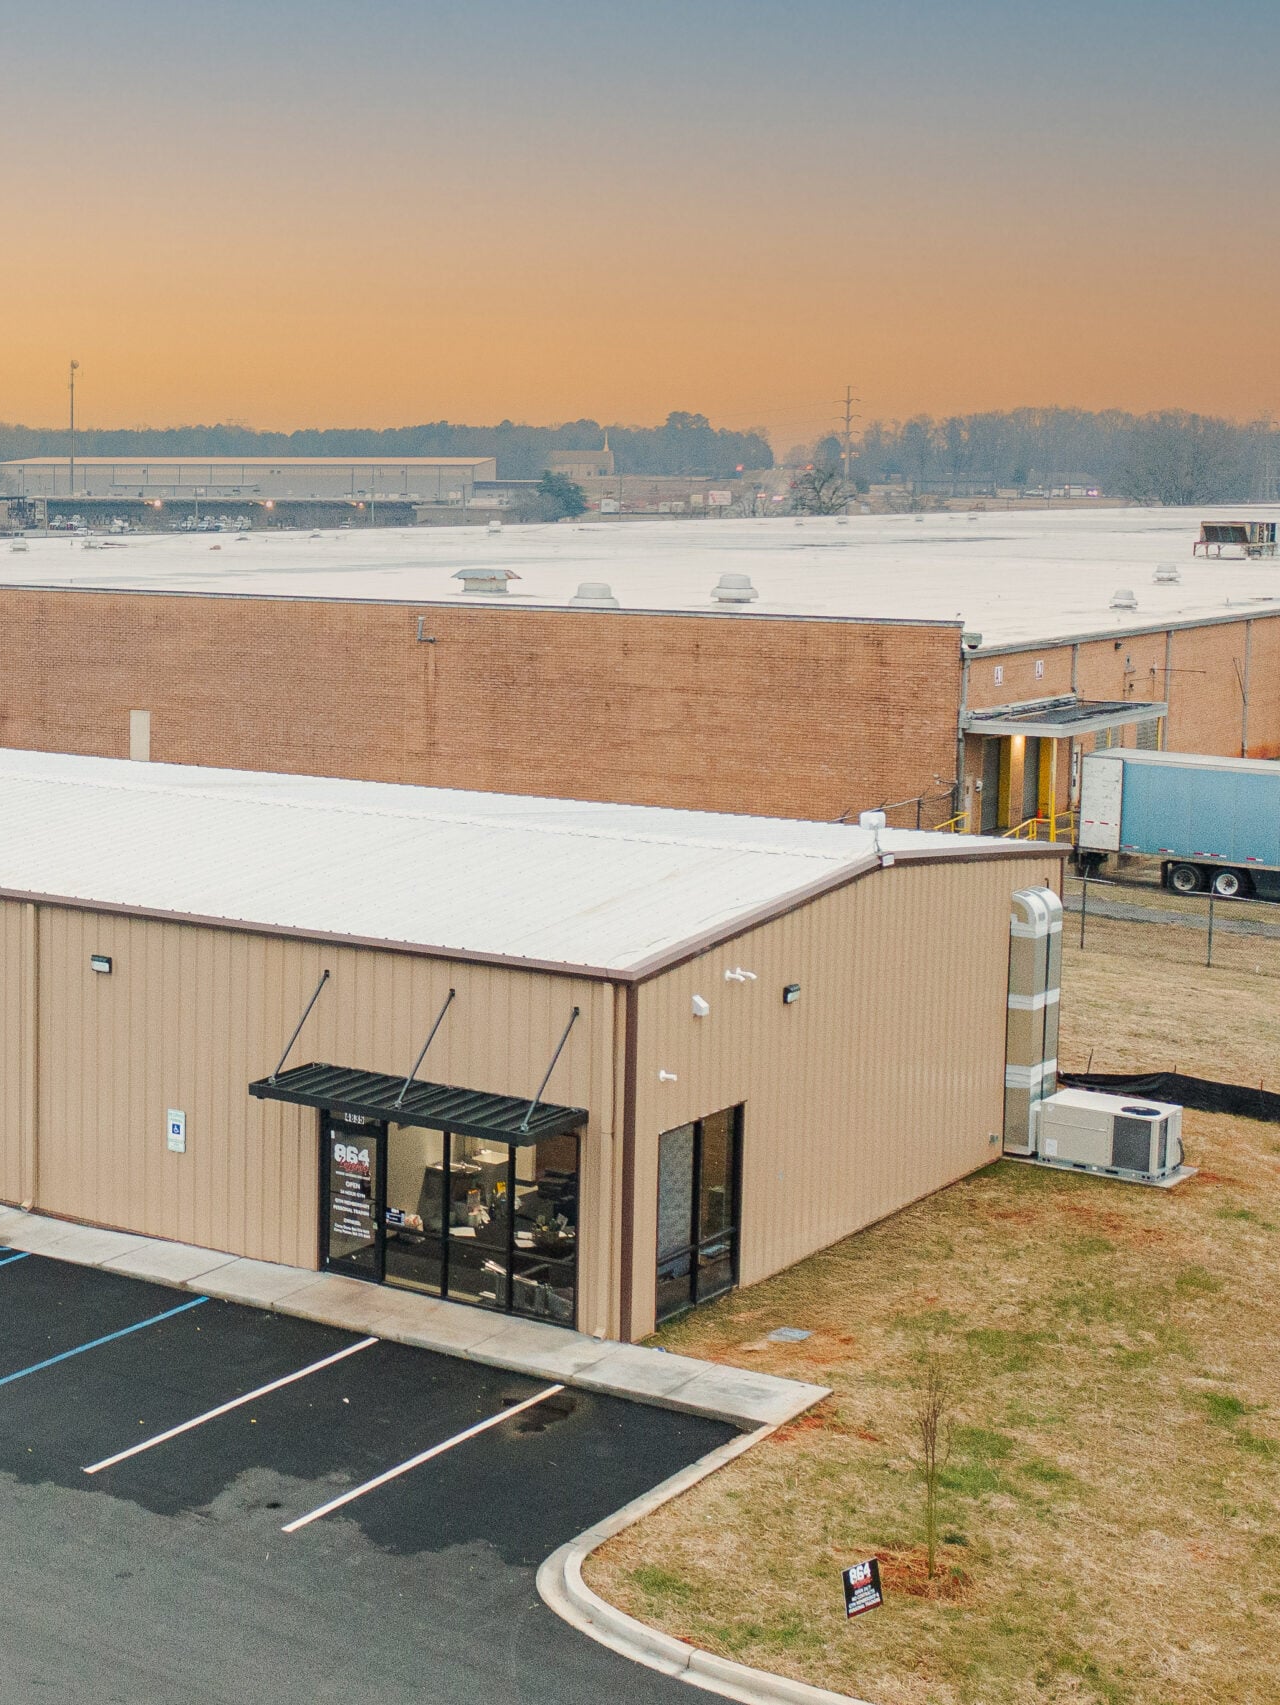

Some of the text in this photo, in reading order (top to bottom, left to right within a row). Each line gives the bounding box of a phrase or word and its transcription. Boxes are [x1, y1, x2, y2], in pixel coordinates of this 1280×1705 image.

[334, 1143, 370, 1168] 864
[345, 1181, 361, 1190] OPEN
[849, 1562, 872, 1586] 864
